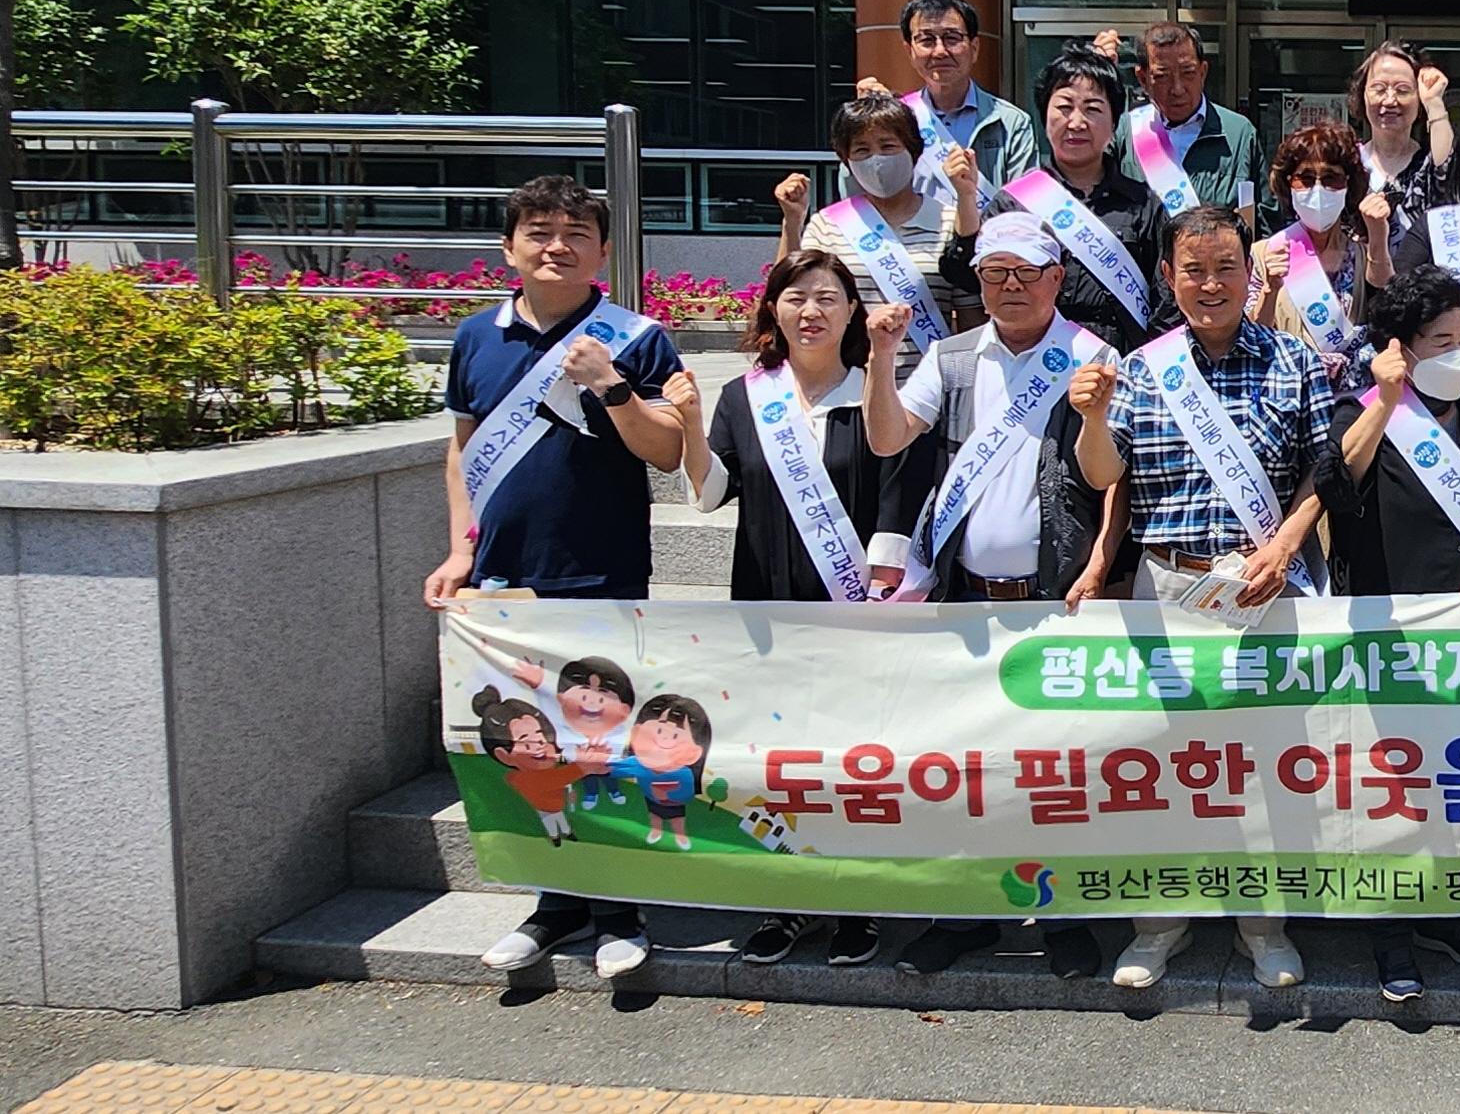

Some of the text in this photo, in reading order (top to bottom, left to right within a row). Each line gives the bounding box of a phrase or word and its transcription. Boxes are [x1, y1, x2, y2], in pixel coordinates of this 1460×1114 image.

[1074, 224, 1119, 270] 평산동
[877, 252, 917, 300] 평산동
[1003, 375, 1051, 428] 평산동
[1180, 390, 1222, 445] 평산동
[773, 425, 811, 483] 평산동
[1040, 645, 1197, 699] 평산동
[763, 743, 985, 826] 도움이
[1014, 738, 1256, 825] 필요한
